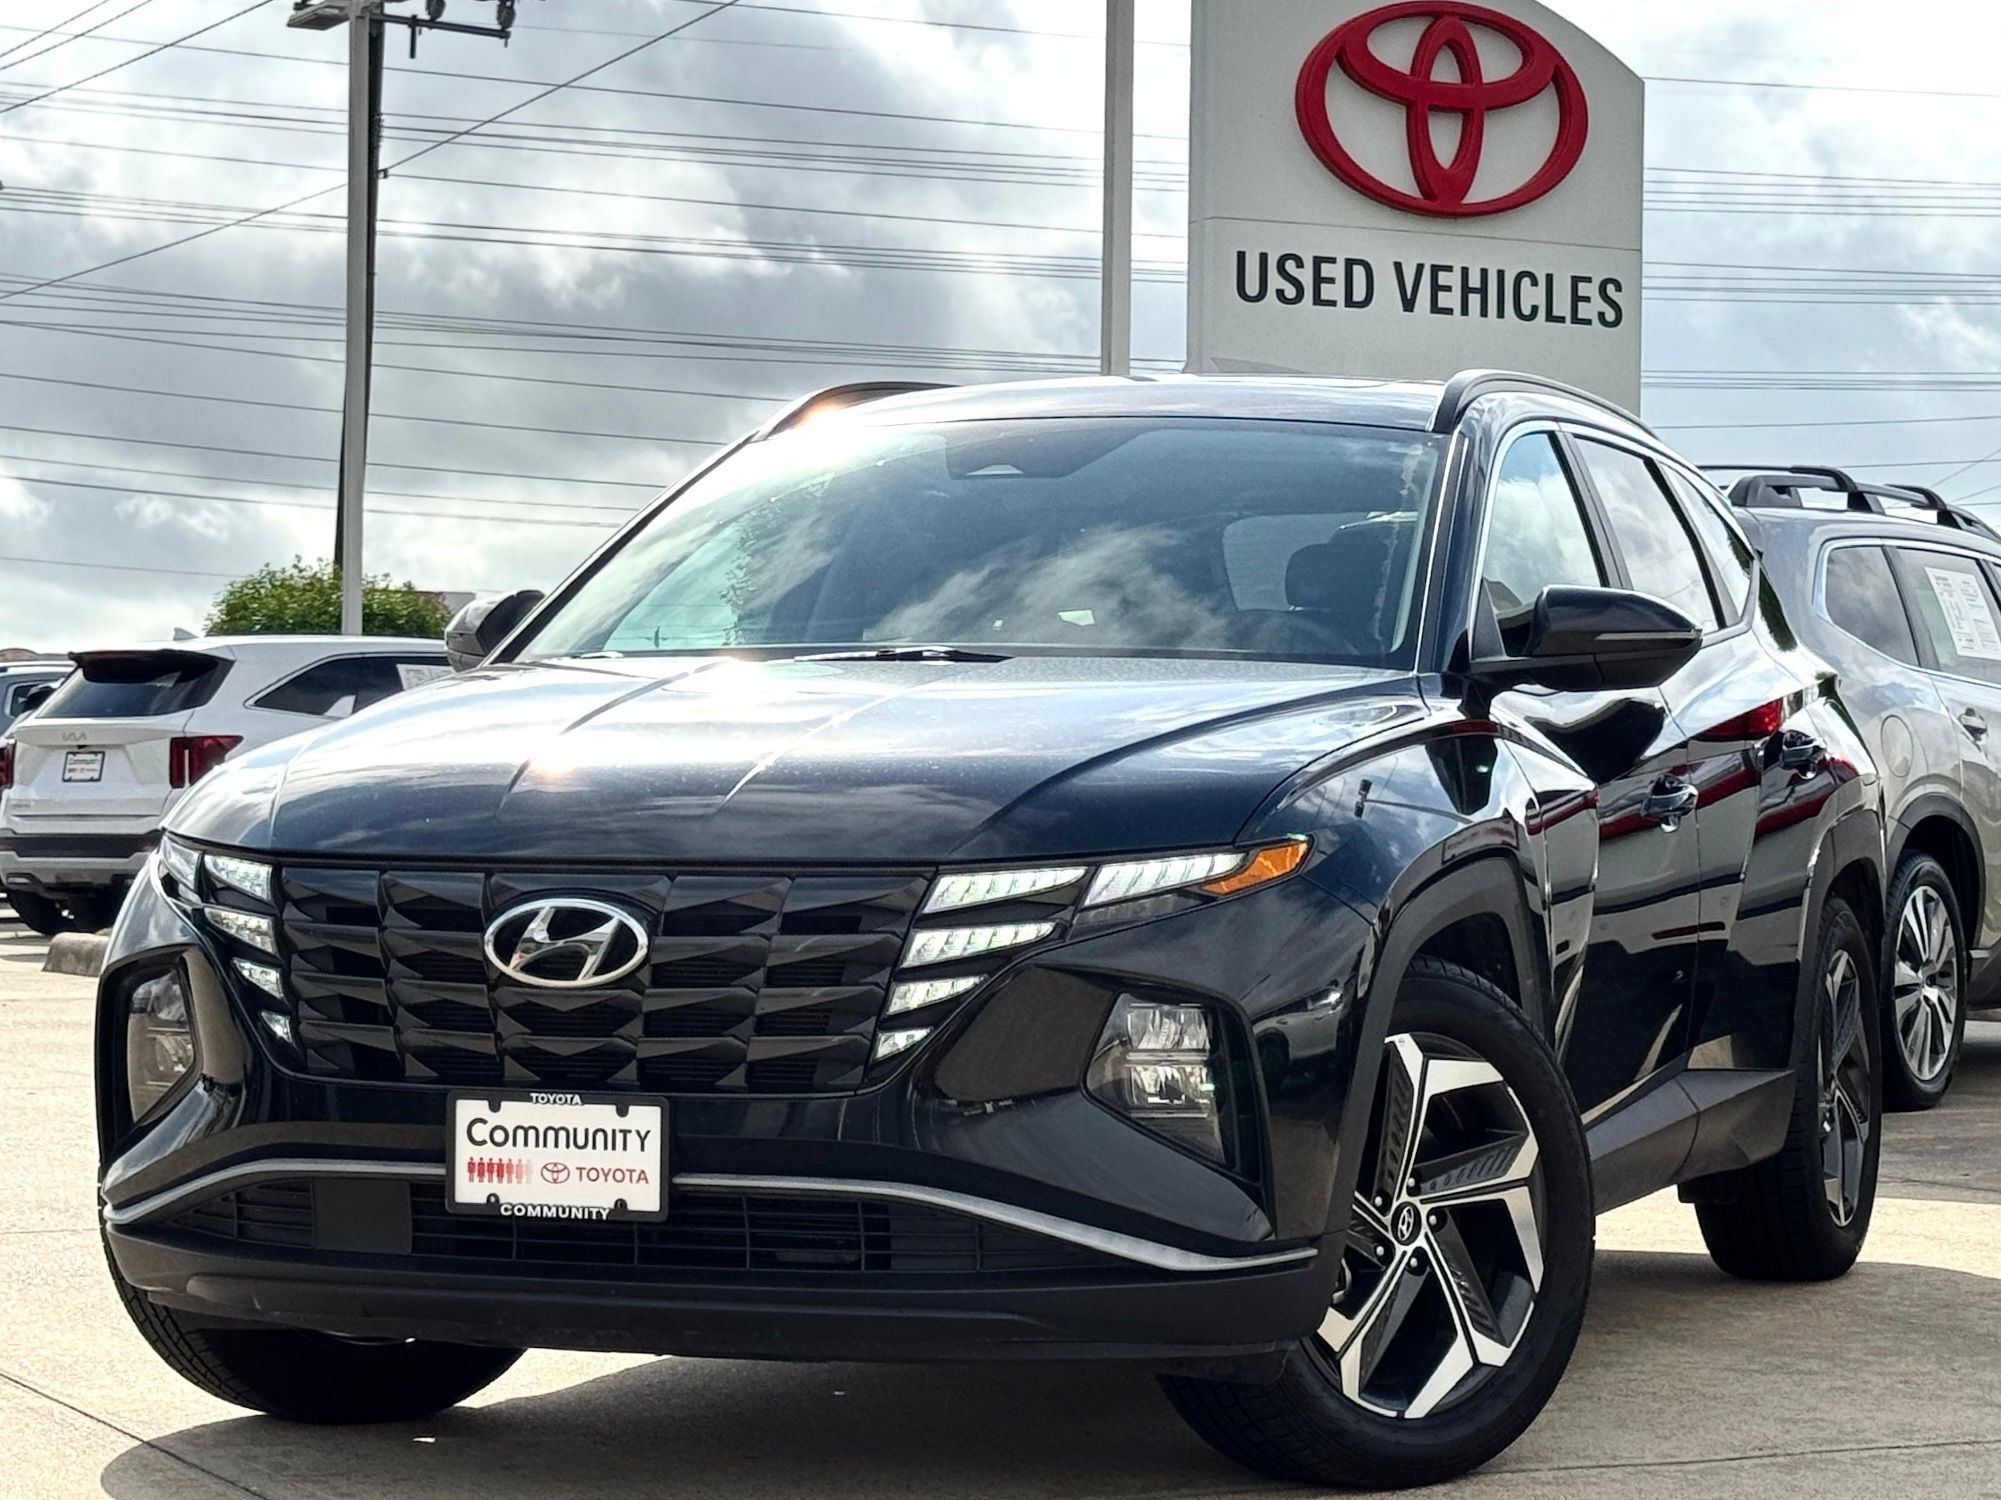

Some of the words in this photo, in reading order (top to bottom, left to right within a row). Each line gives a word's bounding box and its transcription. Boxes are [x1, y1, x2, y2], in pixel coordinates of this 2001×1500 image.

[1235, 250, 1374, 309] USED
[1393, 261, 1623, 328] VEHICLES
[530, 1093, 583, 1106] TOYOTA
[575, 1166, 649, 1185] TOYOTA
[500, 1203, 610, 1220] COMMUNITY
